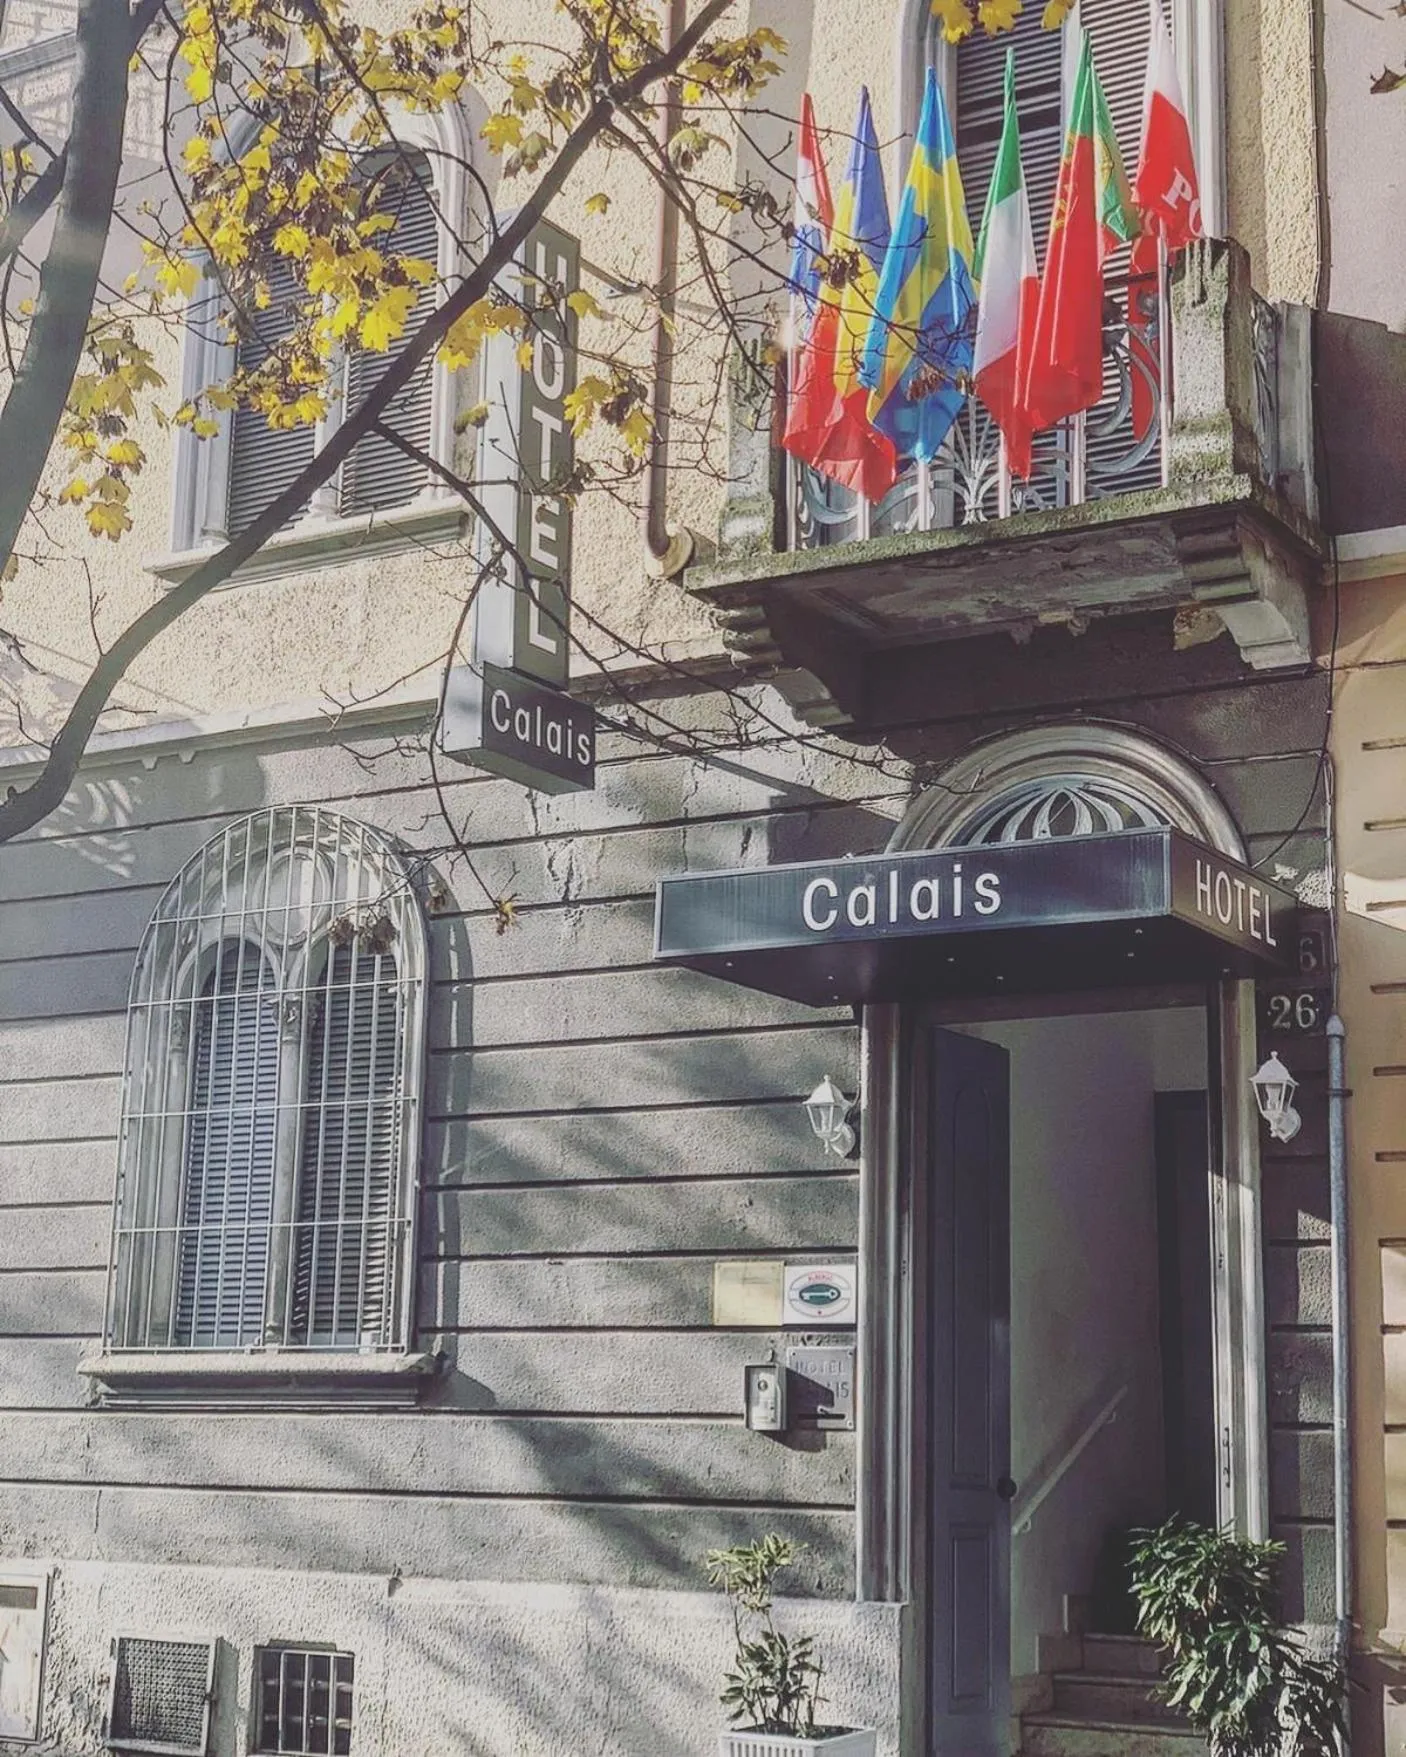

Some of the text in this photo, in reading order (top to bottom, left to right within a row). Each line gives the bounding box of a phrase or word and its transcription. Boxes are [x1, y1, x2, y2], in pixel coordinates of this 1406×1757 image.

[528, 240, 568, 656] HOTEL
[491, 689, 590, 765] Calais
[803, 864, 1001, 931] Calais
[1196, 859, 1277, 947] HOTEL
[1270, 994, 1316, 1029] 26
